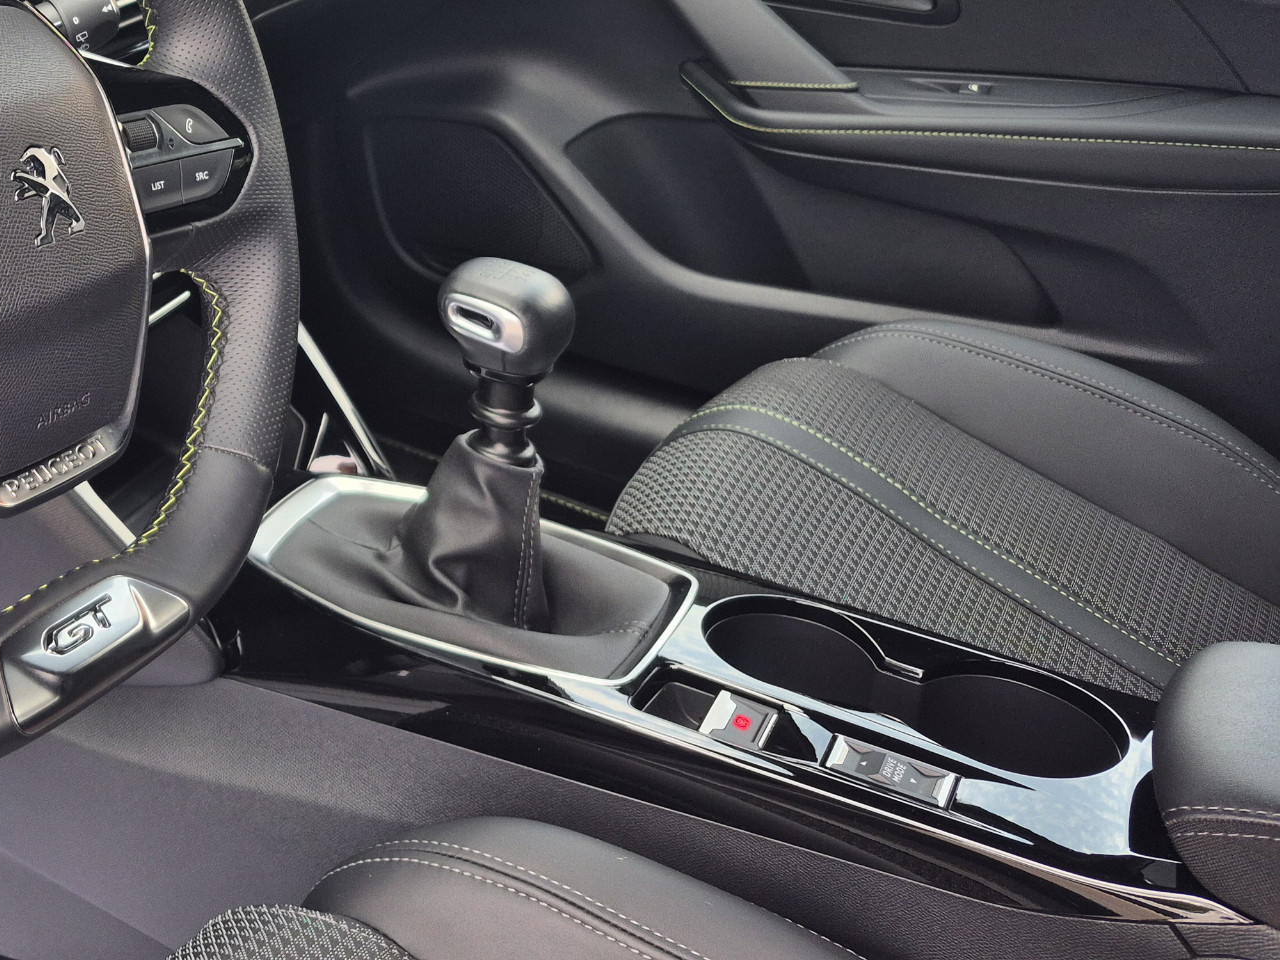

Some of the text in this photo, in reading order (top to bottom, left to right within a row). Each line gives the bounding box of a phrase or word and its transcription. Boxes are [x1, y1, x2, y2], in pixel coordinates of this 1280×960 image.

[151, 180, 165, 191] LIST
[195, 171, 209, 181] SRC
[37, 392, 91, 429] AIRBAG
[2, 435, 106, 498] PEUGEOT
[41, 593, 112, 656] GT
[882, 757, 897, 778] DRIVE
[892, 763, 907, 783] MODE
